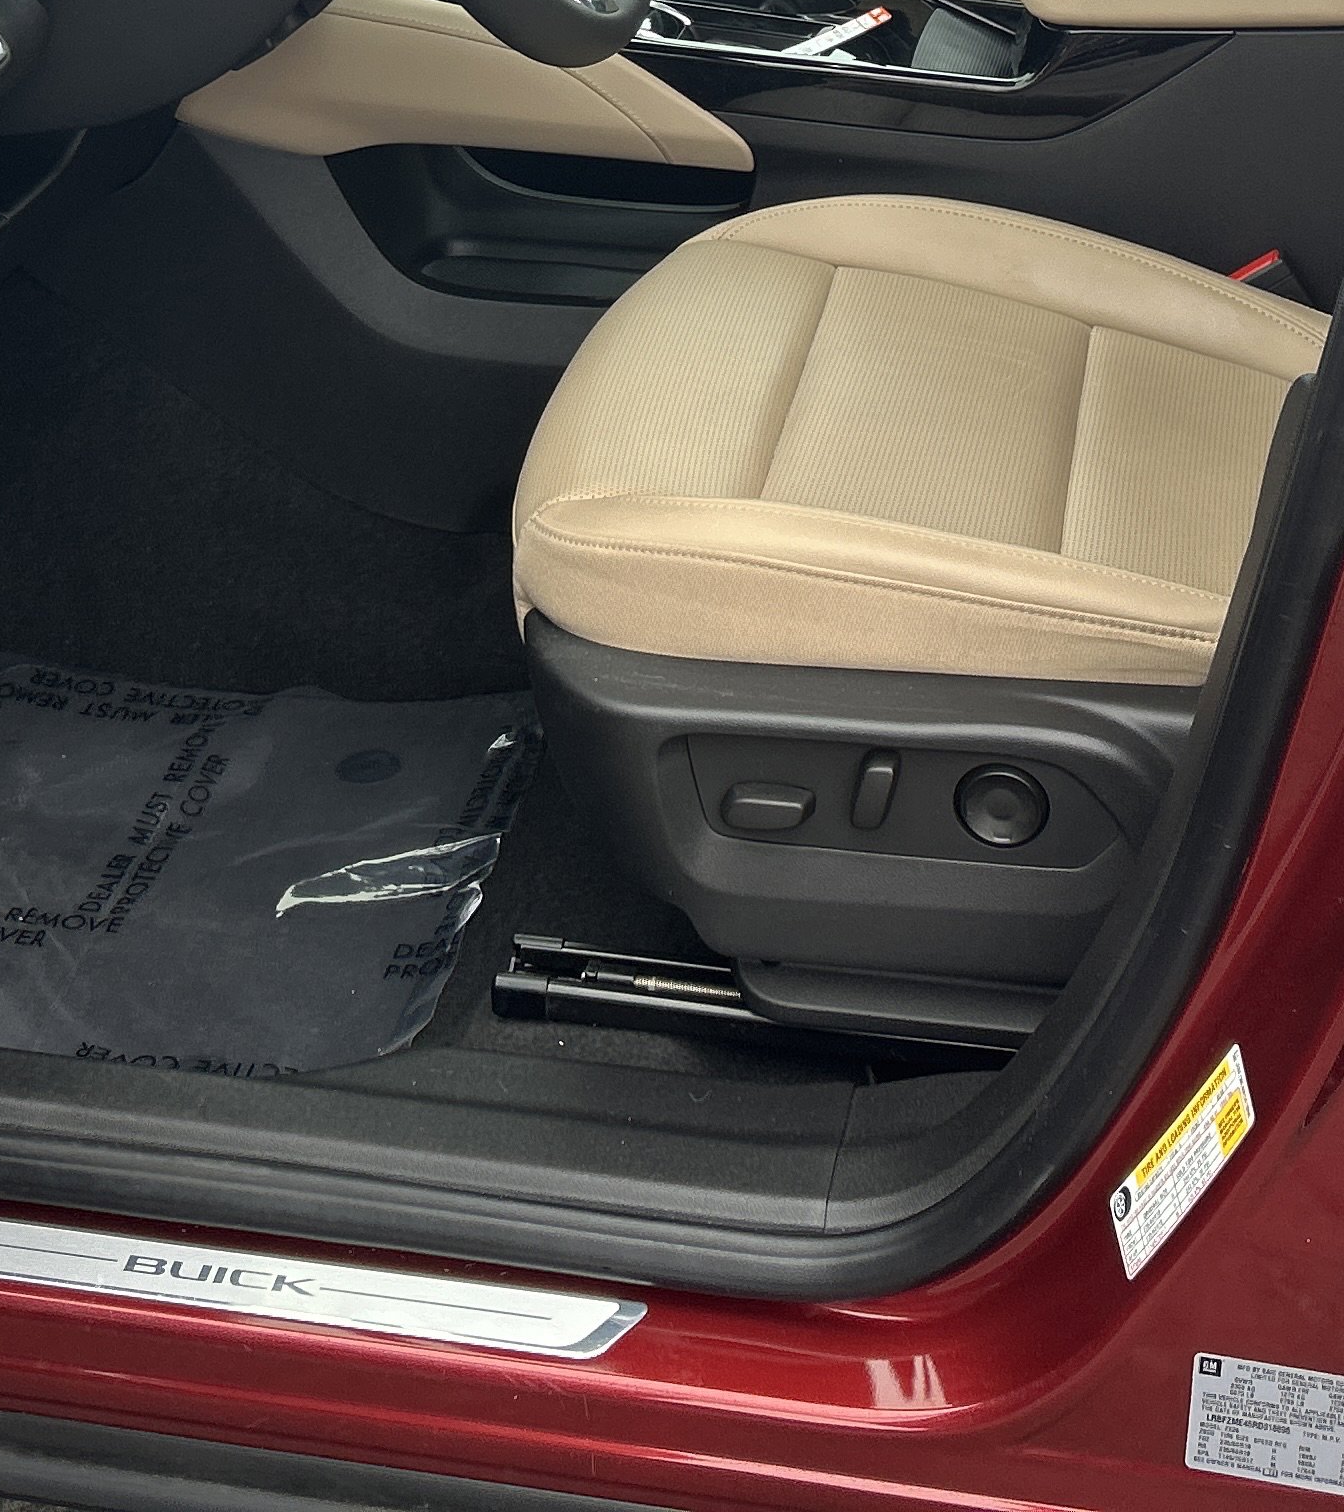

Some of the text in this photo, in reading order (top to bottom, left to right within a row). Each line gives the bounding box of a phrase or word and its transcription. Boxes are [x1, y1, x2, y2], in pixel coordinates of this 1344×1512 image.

[180, 754, 231, 817] COVER
[78, 854, 136, 913] DEALER
[128, 791, 173, 845] MUST
[5, 907, 125, 935] REMOVE
[122, 1253, 314, 1296] BUICK
